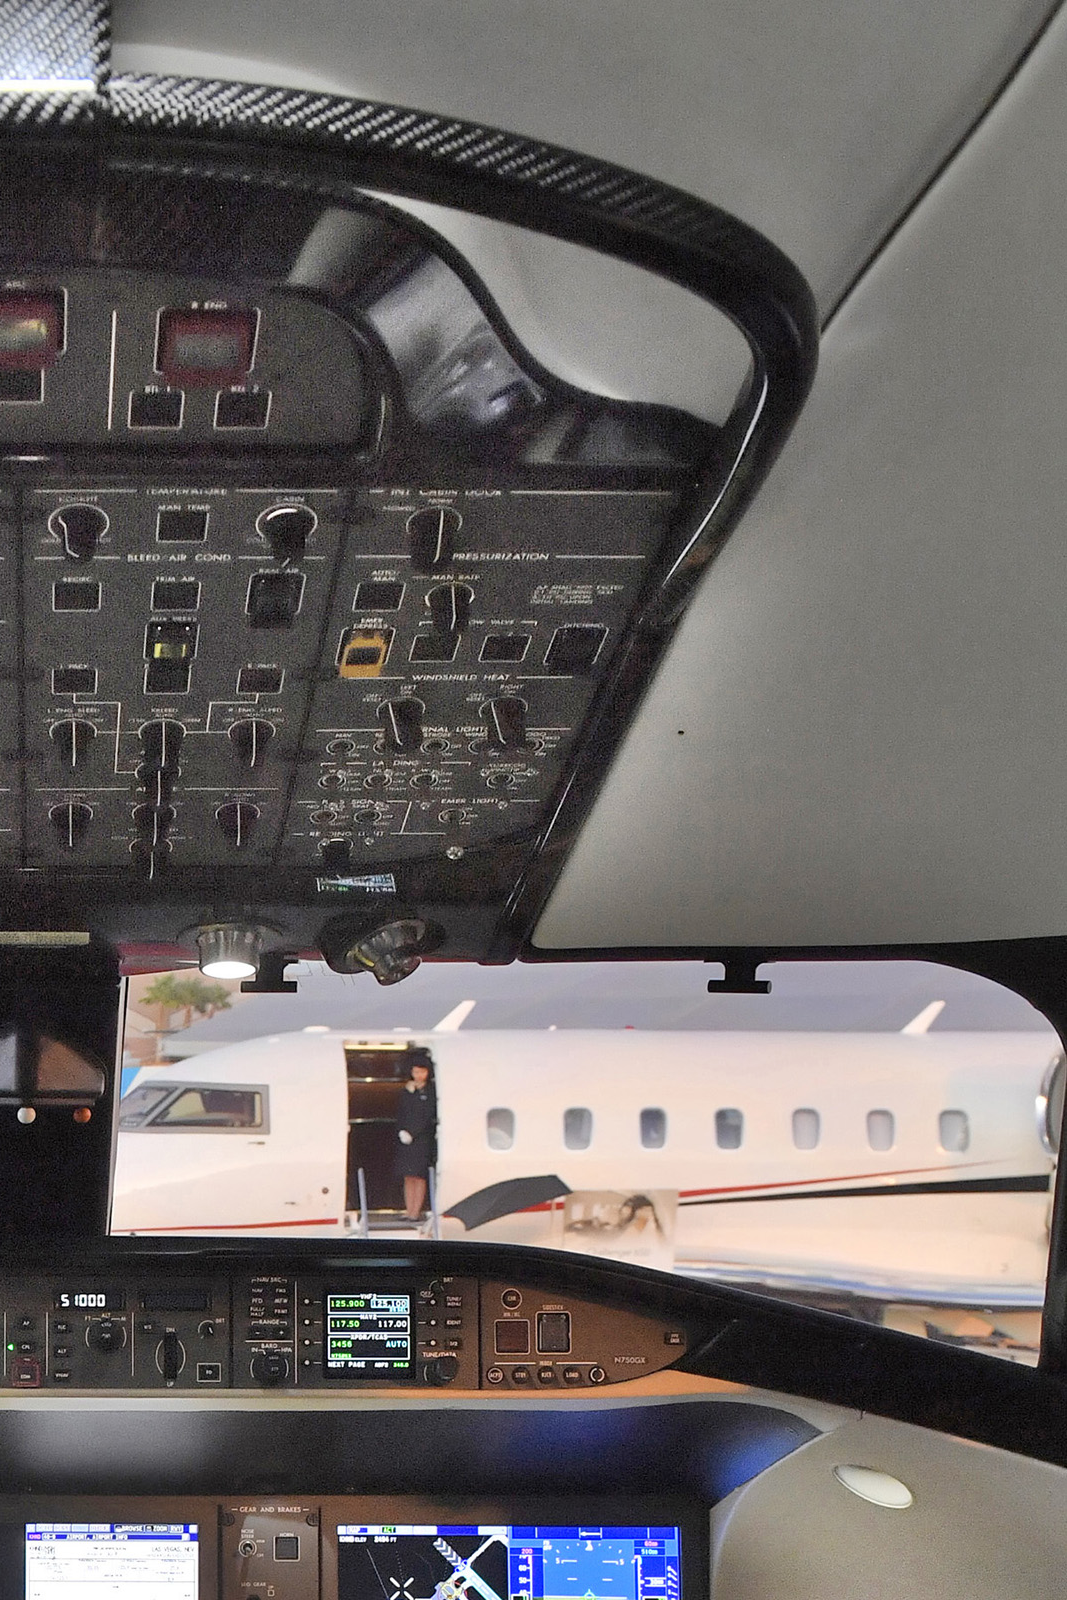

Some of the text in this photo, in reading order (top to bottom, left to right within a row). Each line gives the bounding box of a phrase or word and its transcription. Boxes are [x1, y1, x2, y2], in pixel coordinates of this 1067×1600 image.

[453, 552, 549, 561] PRESSURIZATION
[412, 674, 510, 682] WINDSHIELD HEAT
[331, 1300, 365, 1308] 125.900
[331, 1320, 407, 1329] 117.50 117.00
[386, 1340, 408, 1349] AUTO
[614, 1356, 646, 1365] N750GX
